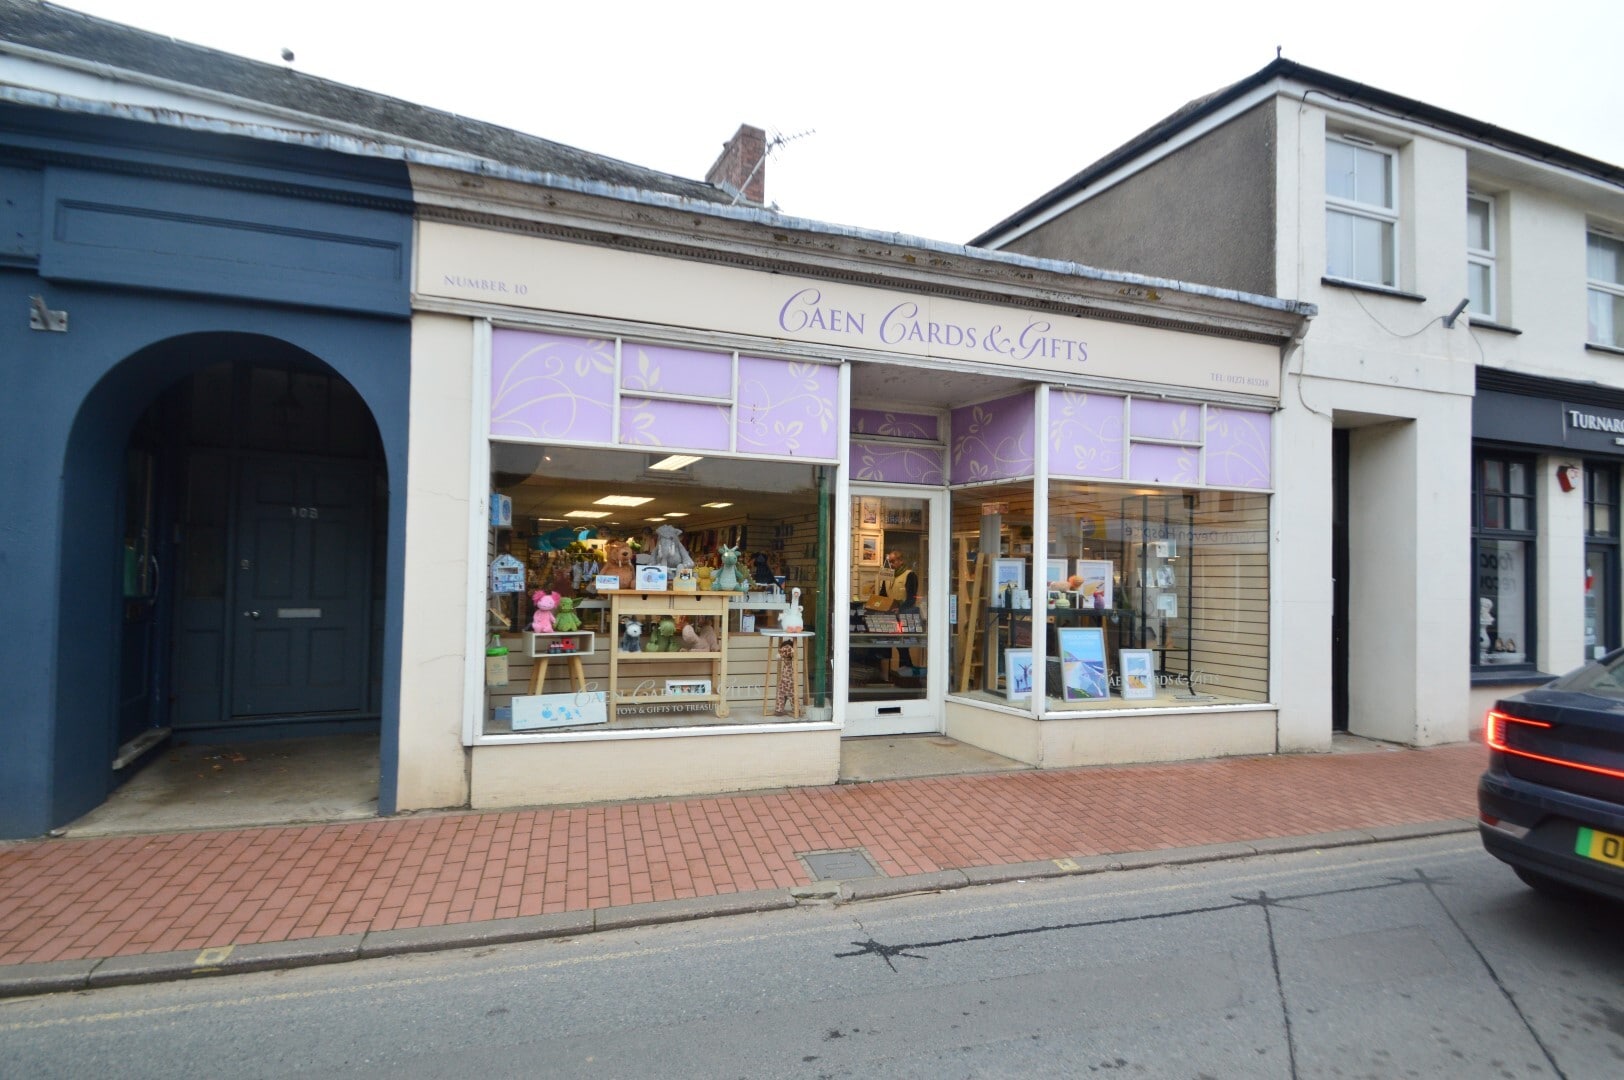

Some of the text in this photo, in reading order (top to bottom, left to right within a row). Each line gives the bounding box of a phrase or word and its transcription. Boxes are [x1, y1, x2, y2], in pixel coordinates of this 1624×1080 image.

[444, 275, 528, 295] NUMBER 10
[779, 288, 1088, 362] CAEN CARDS & GIFTS
[616, 706, 637, 715] TOYS
[639, 706, 645, 714] &
[647, 704, 670, 714] GIFTS
[672, 704, 684, 712] TO
